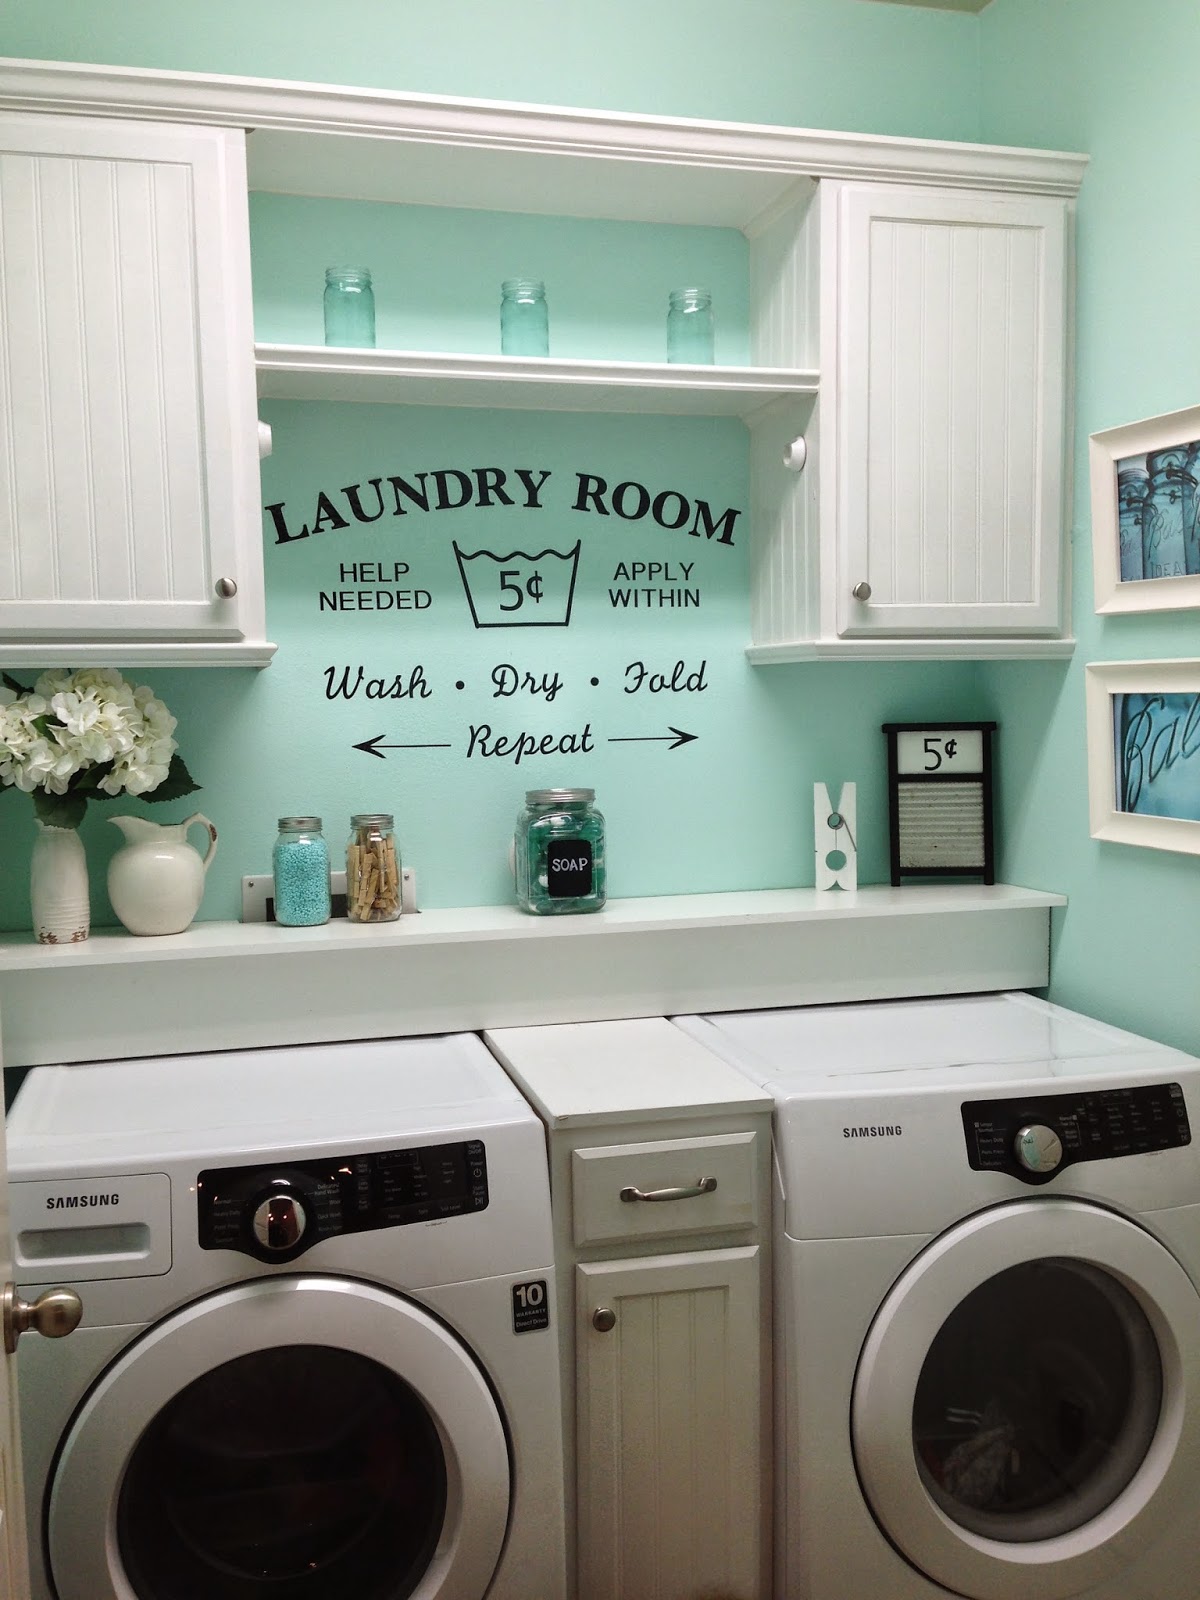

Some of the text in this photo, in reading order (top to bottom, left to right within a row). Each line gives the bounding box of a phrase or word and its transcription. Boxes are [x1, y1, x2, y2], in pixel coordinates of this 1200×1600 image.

[264, 467, 742, 547] LAUNDRY ROOM
[340, 562, 410, 583] HELP
[613, 561, 695, 581] APPLY
[319, 589, 432, 611] NEEDED
[499, 570, 544, 611] 5¢
[608, 588, 700, 608] WITHIN
[324, 660, 708, 702] Wash Dry Fold
[466, 723, 594, 765] Repeat
[923, 738, 957, 771] 5¢
[552, 858, 588, 872] SOAP
[843, 1125, 902, 1138] SAMSUNG
[47, 1193, 120, 1210] SAMSUNG
[516, 1283, 543, 1308] 10
